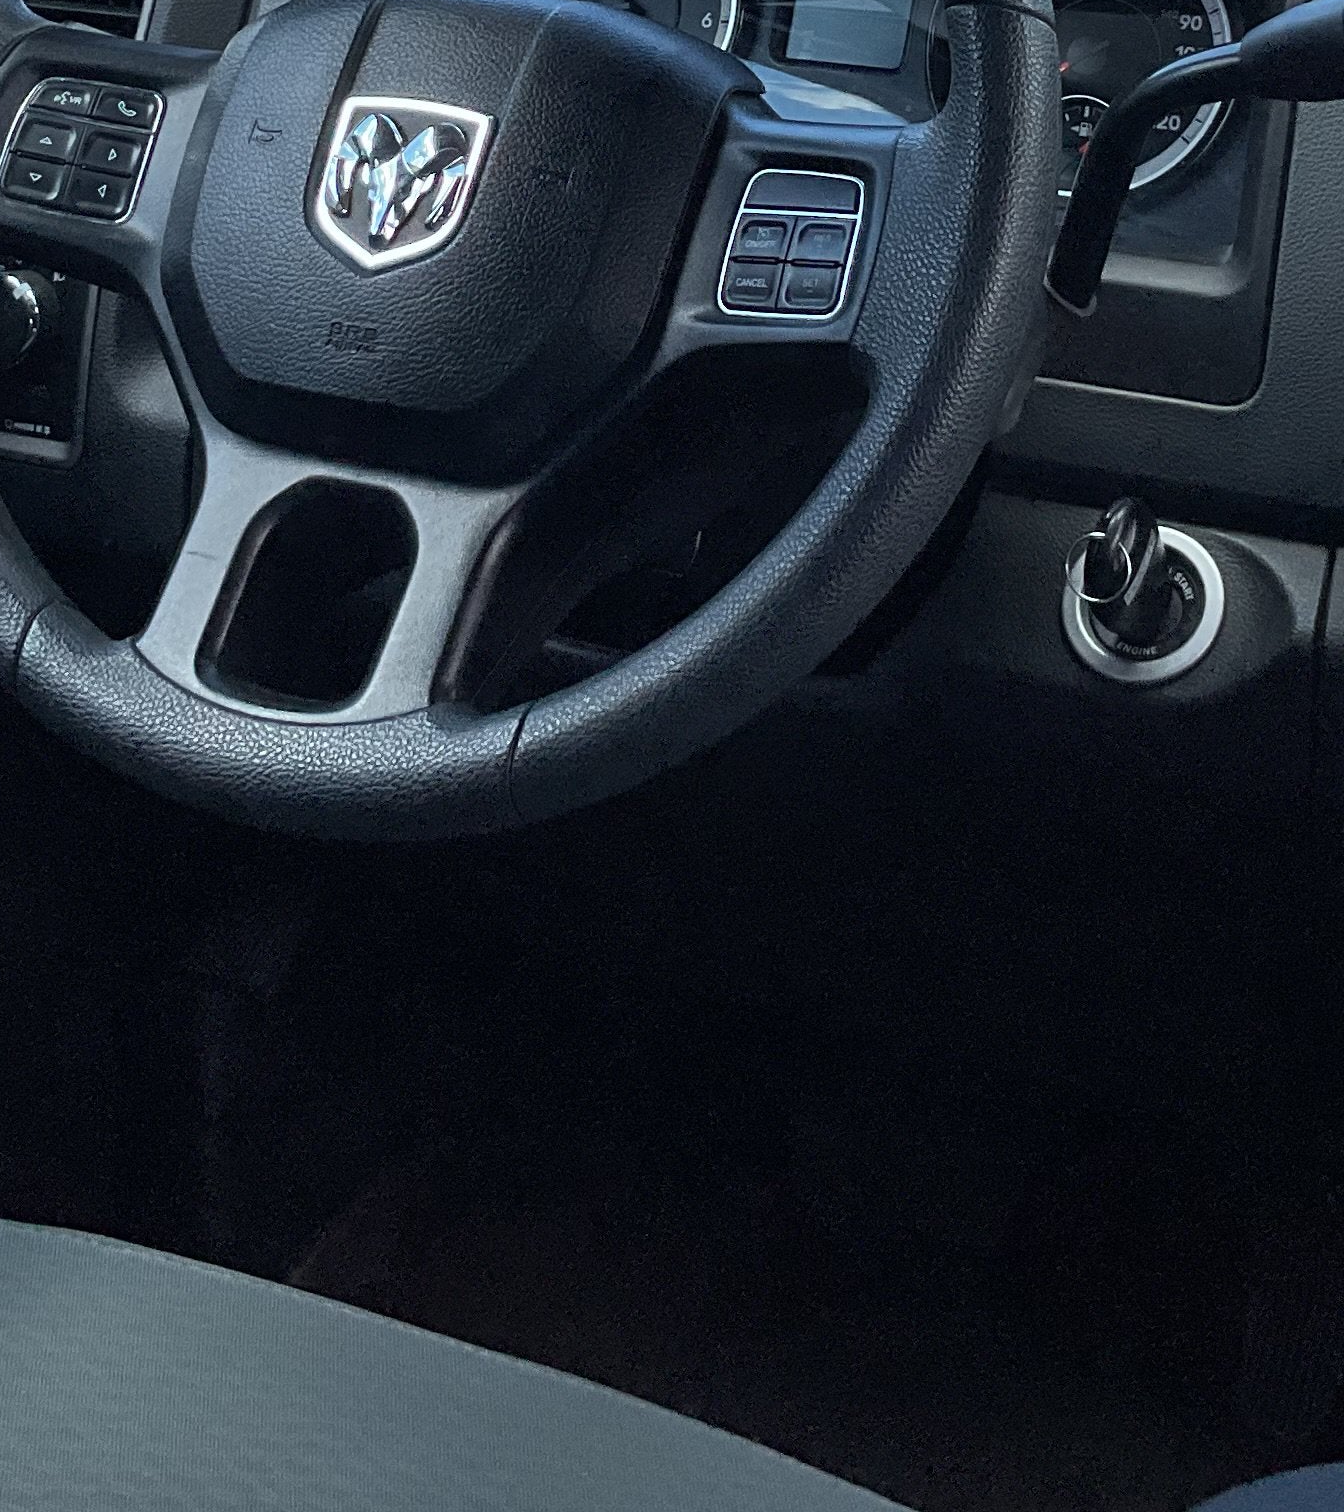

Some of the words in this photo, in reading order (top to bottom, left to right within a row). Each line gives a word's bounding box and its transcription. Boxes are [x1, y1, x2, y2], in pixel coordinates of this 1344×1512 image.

[702, 13, 713, 28] 6
[1179, 15, 1203, 30] 90
[70, 96, 82, 104] VR
[736, 278, 768, 288] CANCEL
[802, 278, 820, 287] SET
[1174, 572, 1193, 600] START
[1116, 641, 1159, 656] ENGINE
